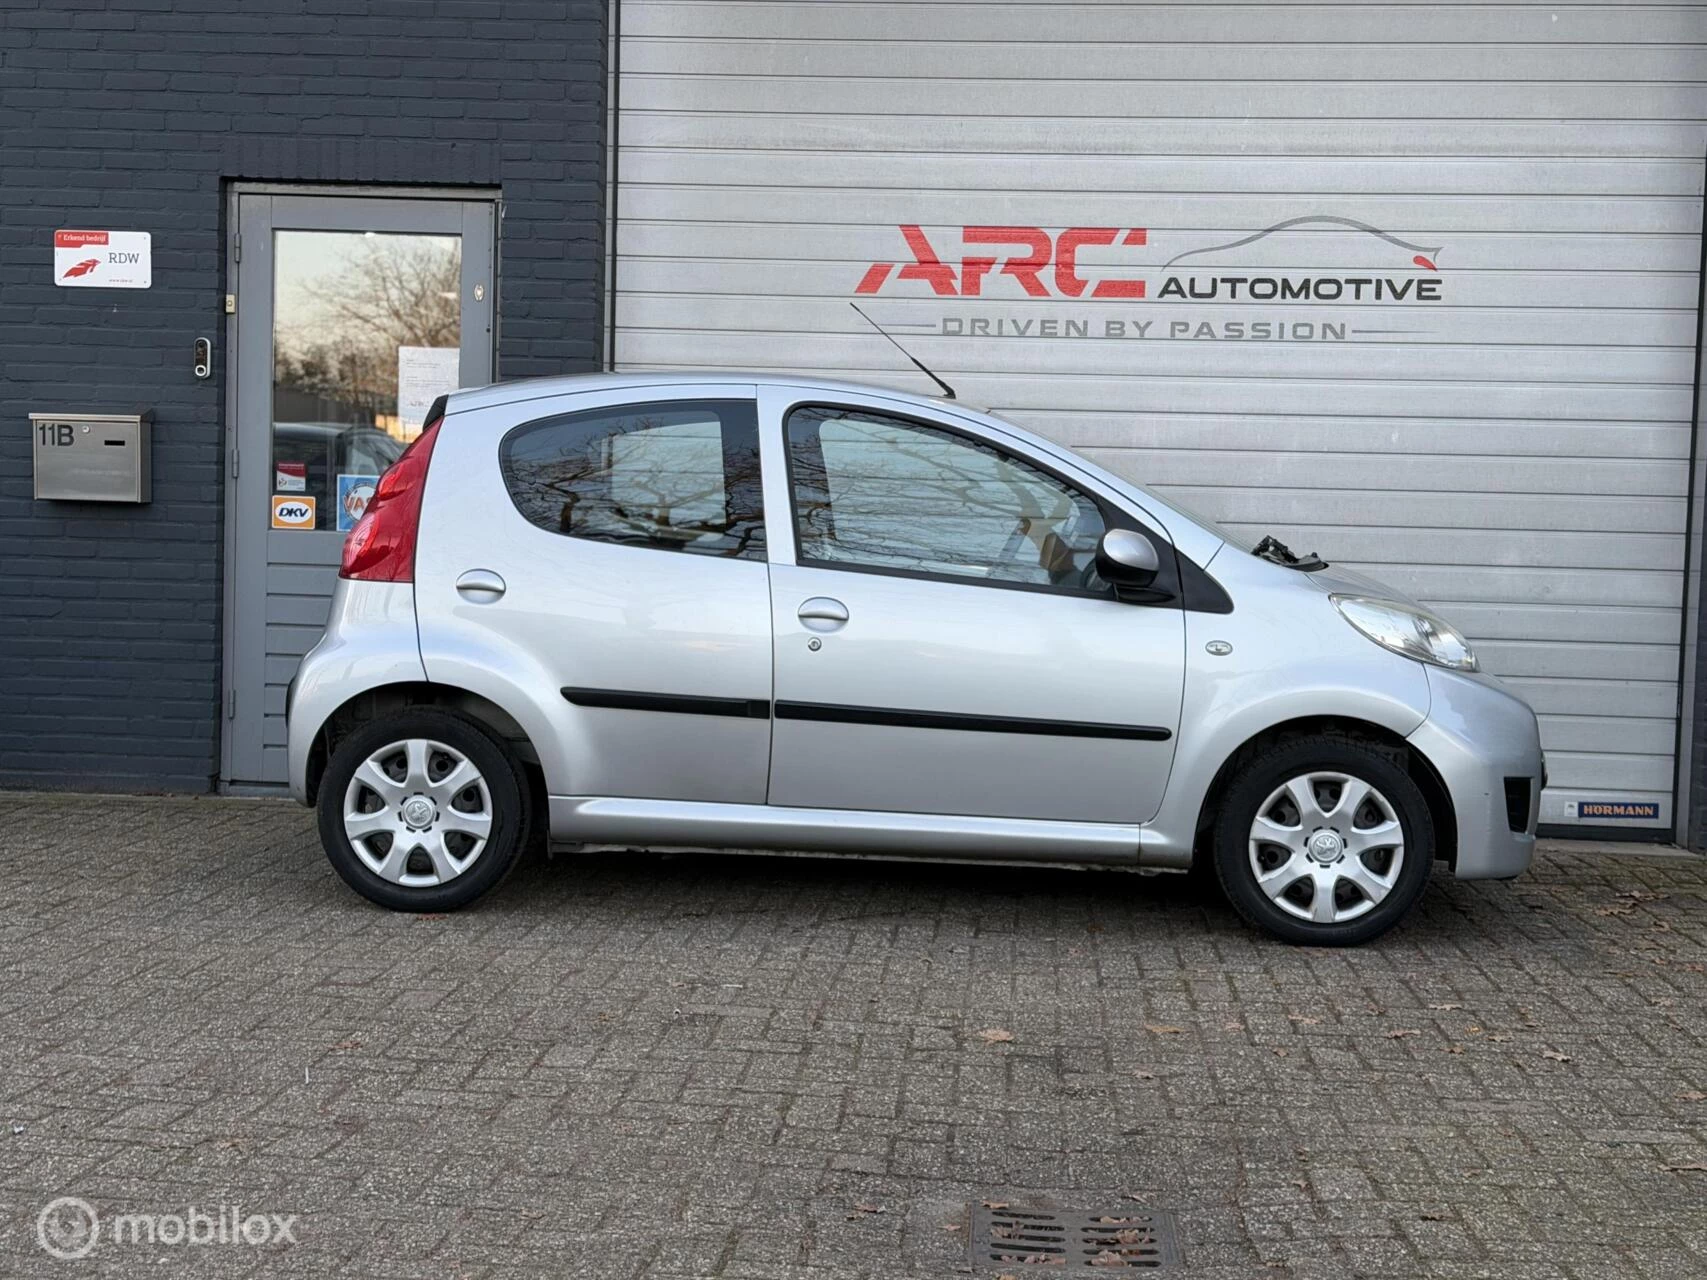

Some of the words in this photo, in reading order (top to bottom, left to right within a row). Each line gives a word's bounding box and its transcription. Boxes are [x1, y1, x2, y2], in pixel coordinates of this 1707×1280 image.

[63, 233, 85, 241] Erkend
[108, 252, 140, 264] RDW
[854, 225, 1147, 298] ARC
[1157, 277, 1443, 301] AUTOMOTIVE
[942, 318, 1089, 337] DRIVEN
[1105, 320, 1153, 338] BY
[1170, 321, 1346, 341] PASSION
[39, 424, 75, 447] 11B
[279, 507, 309, 518] DKV
